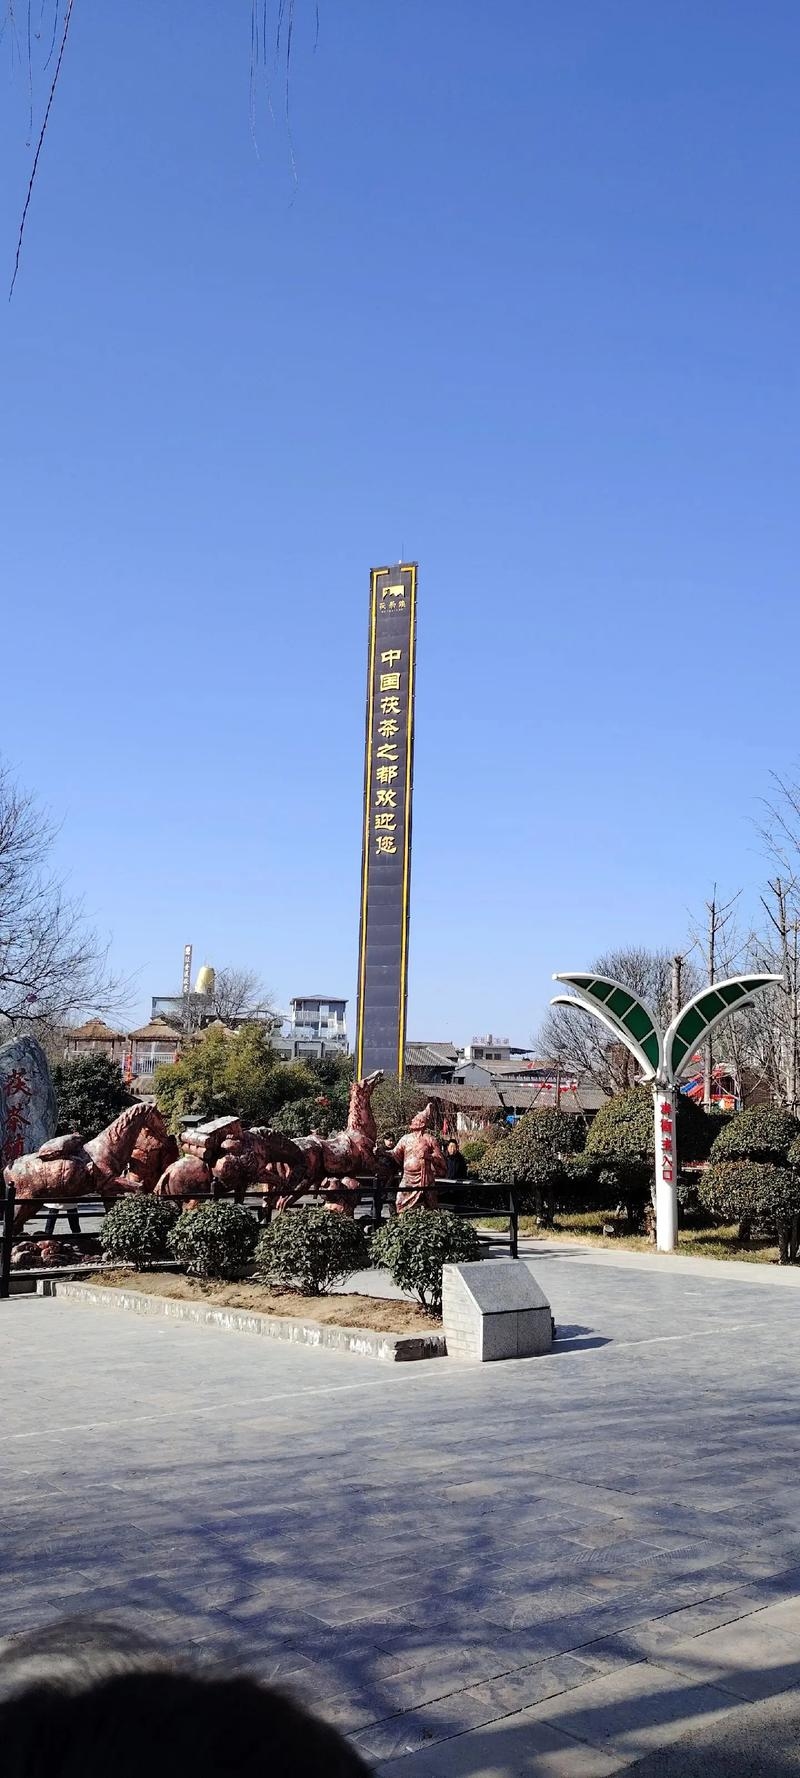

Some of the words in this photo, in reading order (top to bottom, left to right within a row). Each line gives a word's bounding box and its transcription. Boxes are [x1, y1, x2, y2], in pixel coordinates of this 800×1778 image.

[374, 649, 402, 855] 中国茯茶之都欢迎您
